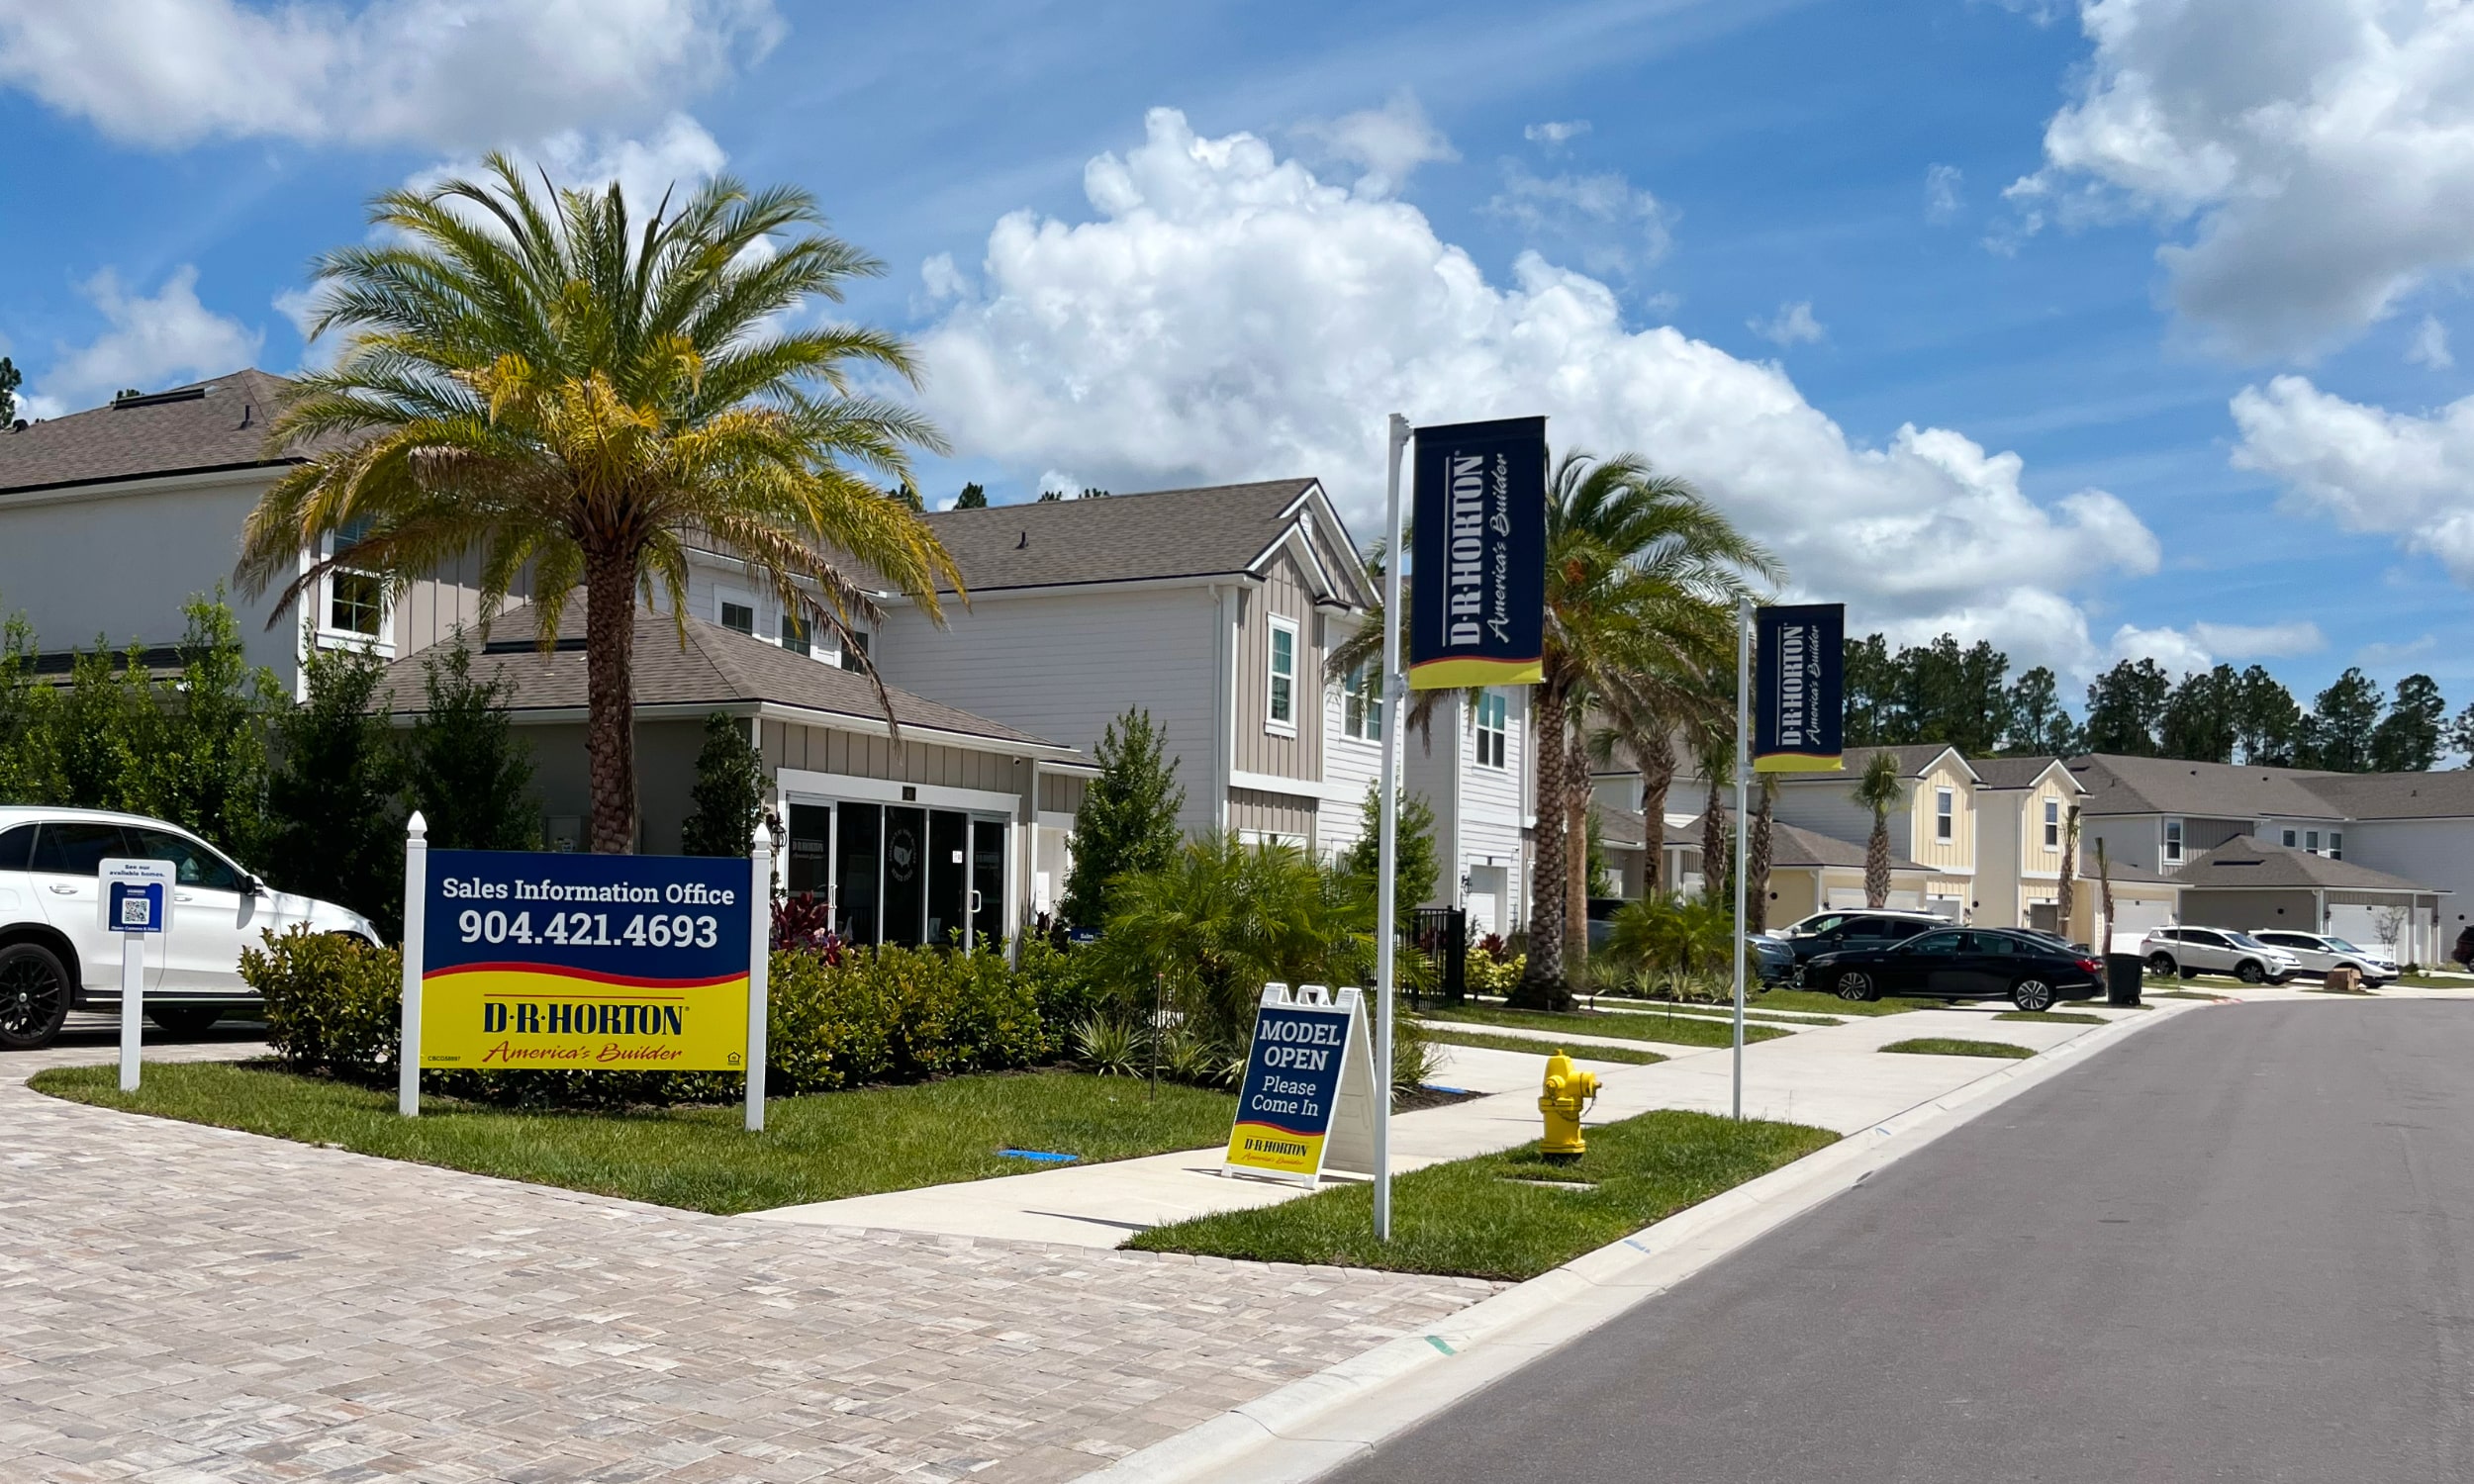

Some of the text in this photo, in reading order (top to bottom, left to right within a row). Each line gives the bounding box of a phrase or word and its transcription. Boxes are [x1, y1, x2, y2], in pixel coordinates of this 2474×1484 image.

[1486, 452, 1511, 644] America's Builder
[1805, 624, 1822, 745] America's Builder
[442, 877, 735, 905] Sales Information Office
[458, 909, 718, 948] 904.421.4693
[1259, 1019, 1341, 1047] MODEL
[482, 1040, 683, 1063] America's Builder
[1264, 1046, 1329, 1071] OPEN
[1262, 1075, 1316, 1096] Please
[1251, 1094, 1319, 1117] Come In
